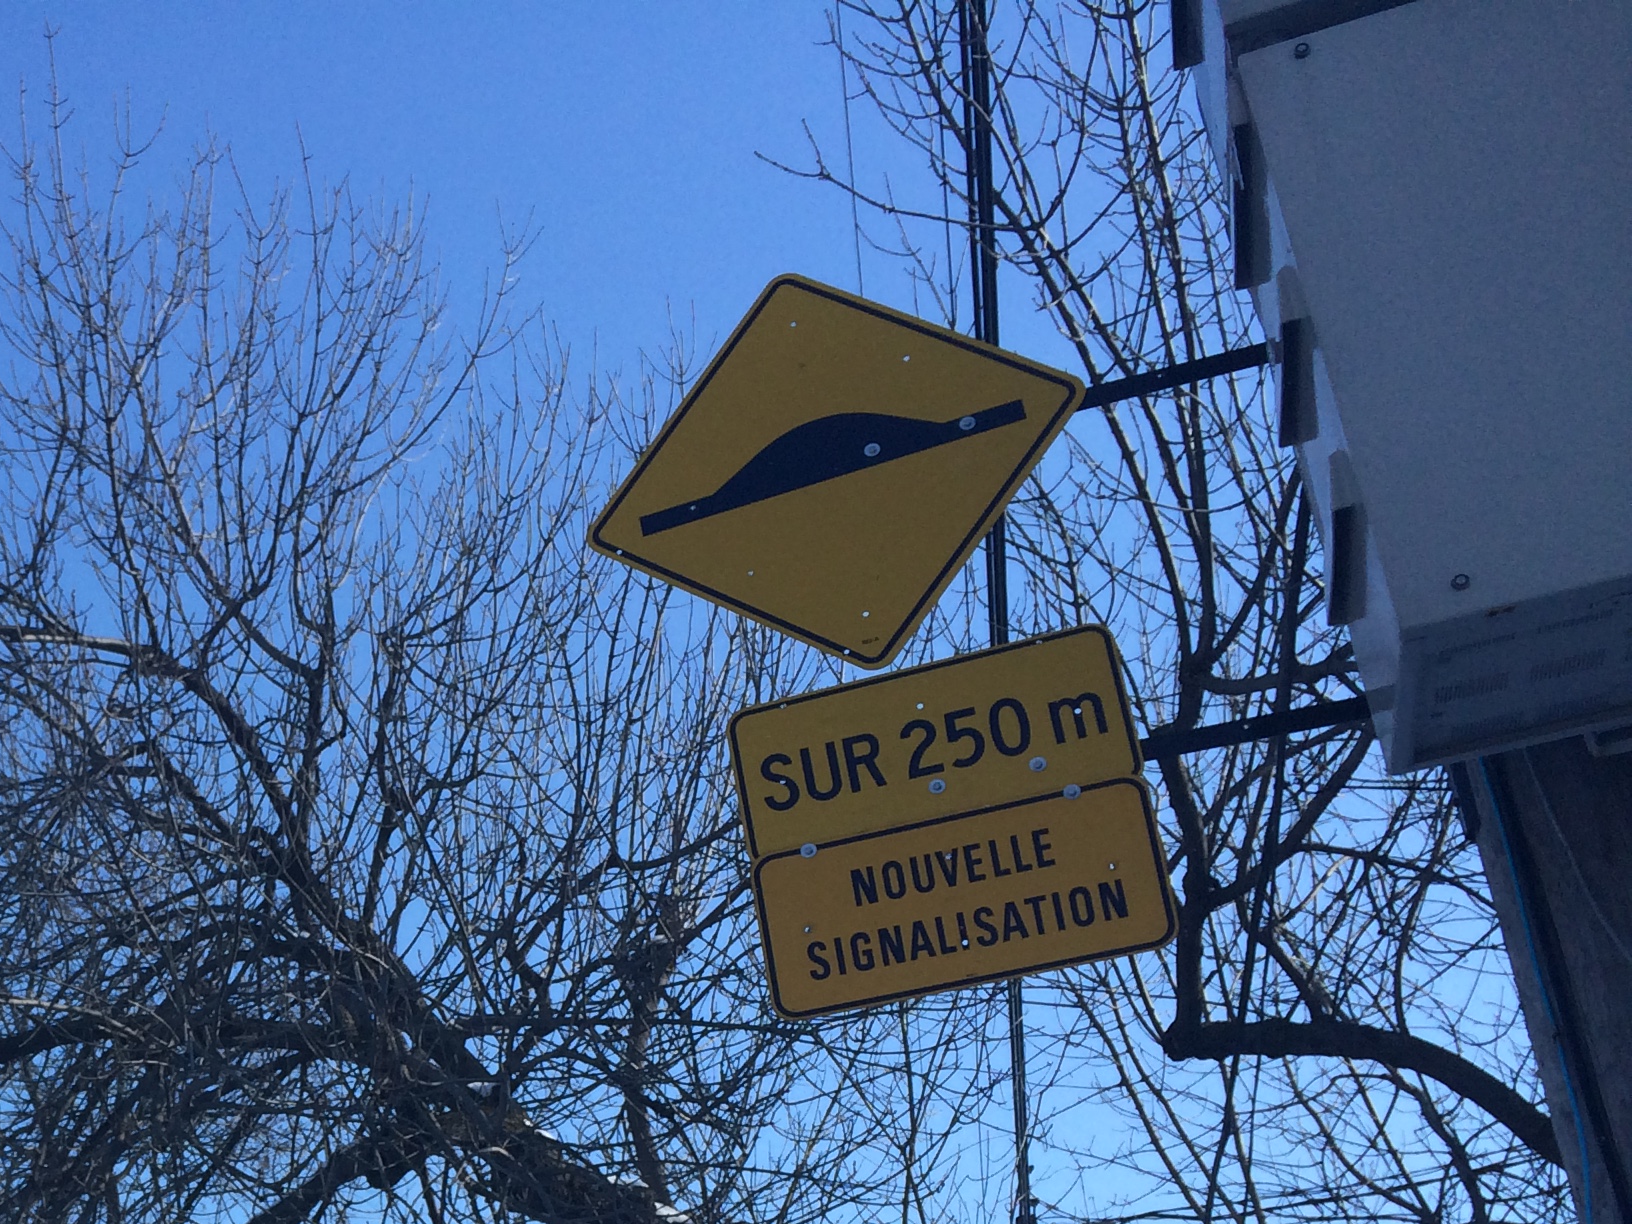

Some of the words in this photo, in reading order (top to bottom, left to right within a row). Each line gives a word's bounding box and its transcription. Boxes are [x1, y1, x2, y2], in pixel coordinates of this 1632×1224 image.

[760, 734, 887, 811] SUR
[899, 698, 1031, 779] 250
[1048, 692, 1109, 744] m
[850, 828, 1056, 907] NOUVELLE
[806, 879, 1129, 981] SIGNALISATION
